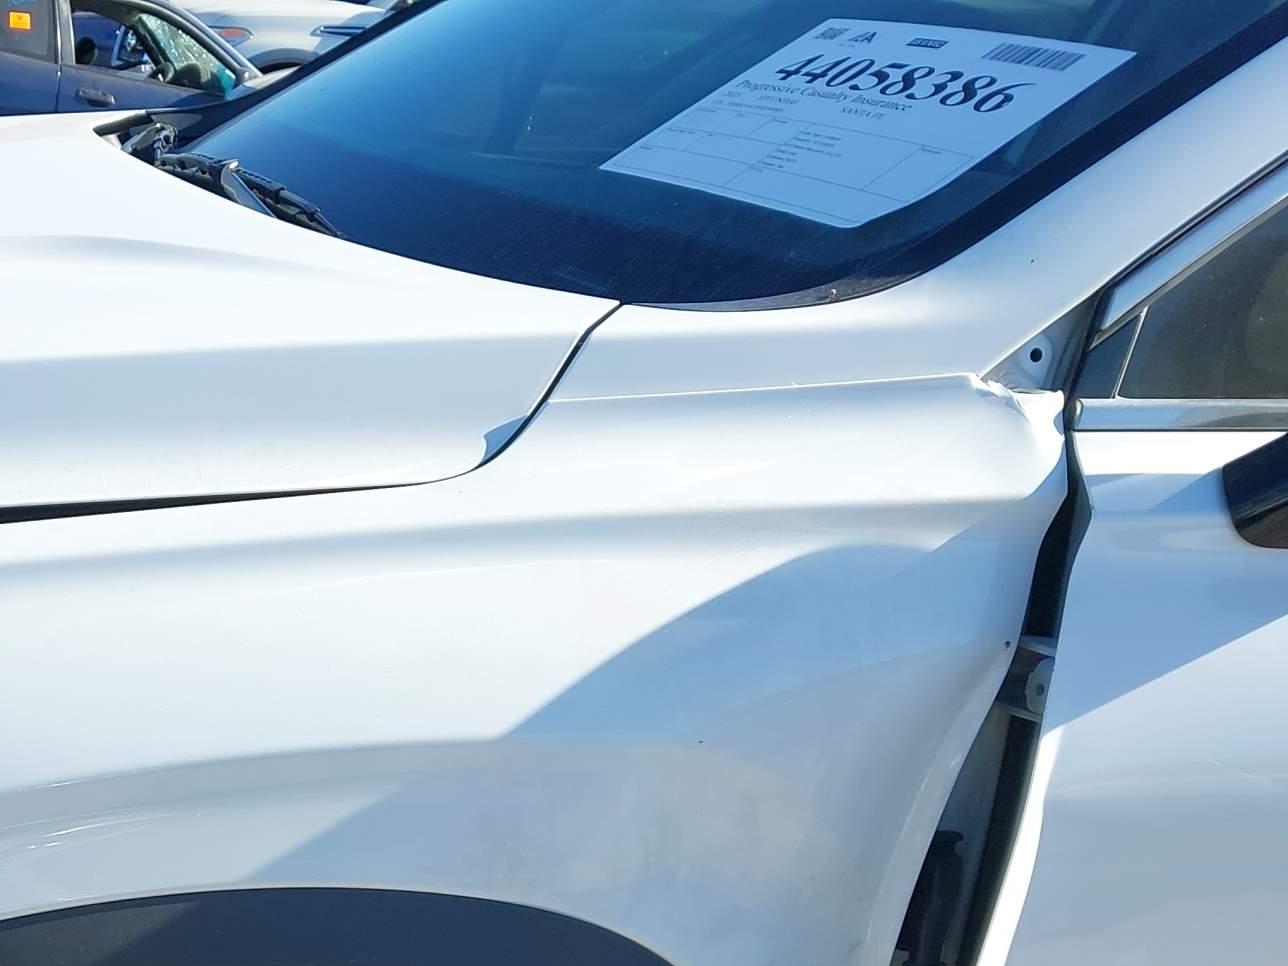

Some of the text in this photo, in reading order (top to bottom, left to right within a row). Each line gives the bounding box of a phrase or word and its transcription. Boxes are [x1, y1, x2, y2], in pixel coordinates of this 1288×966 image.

[736, 79, 801, 96] Progressive
[800, 86, 849, 103] Casualty
[851, 93, 913, 112] Insurance
[775, 54, 1037, 113] 44058386
